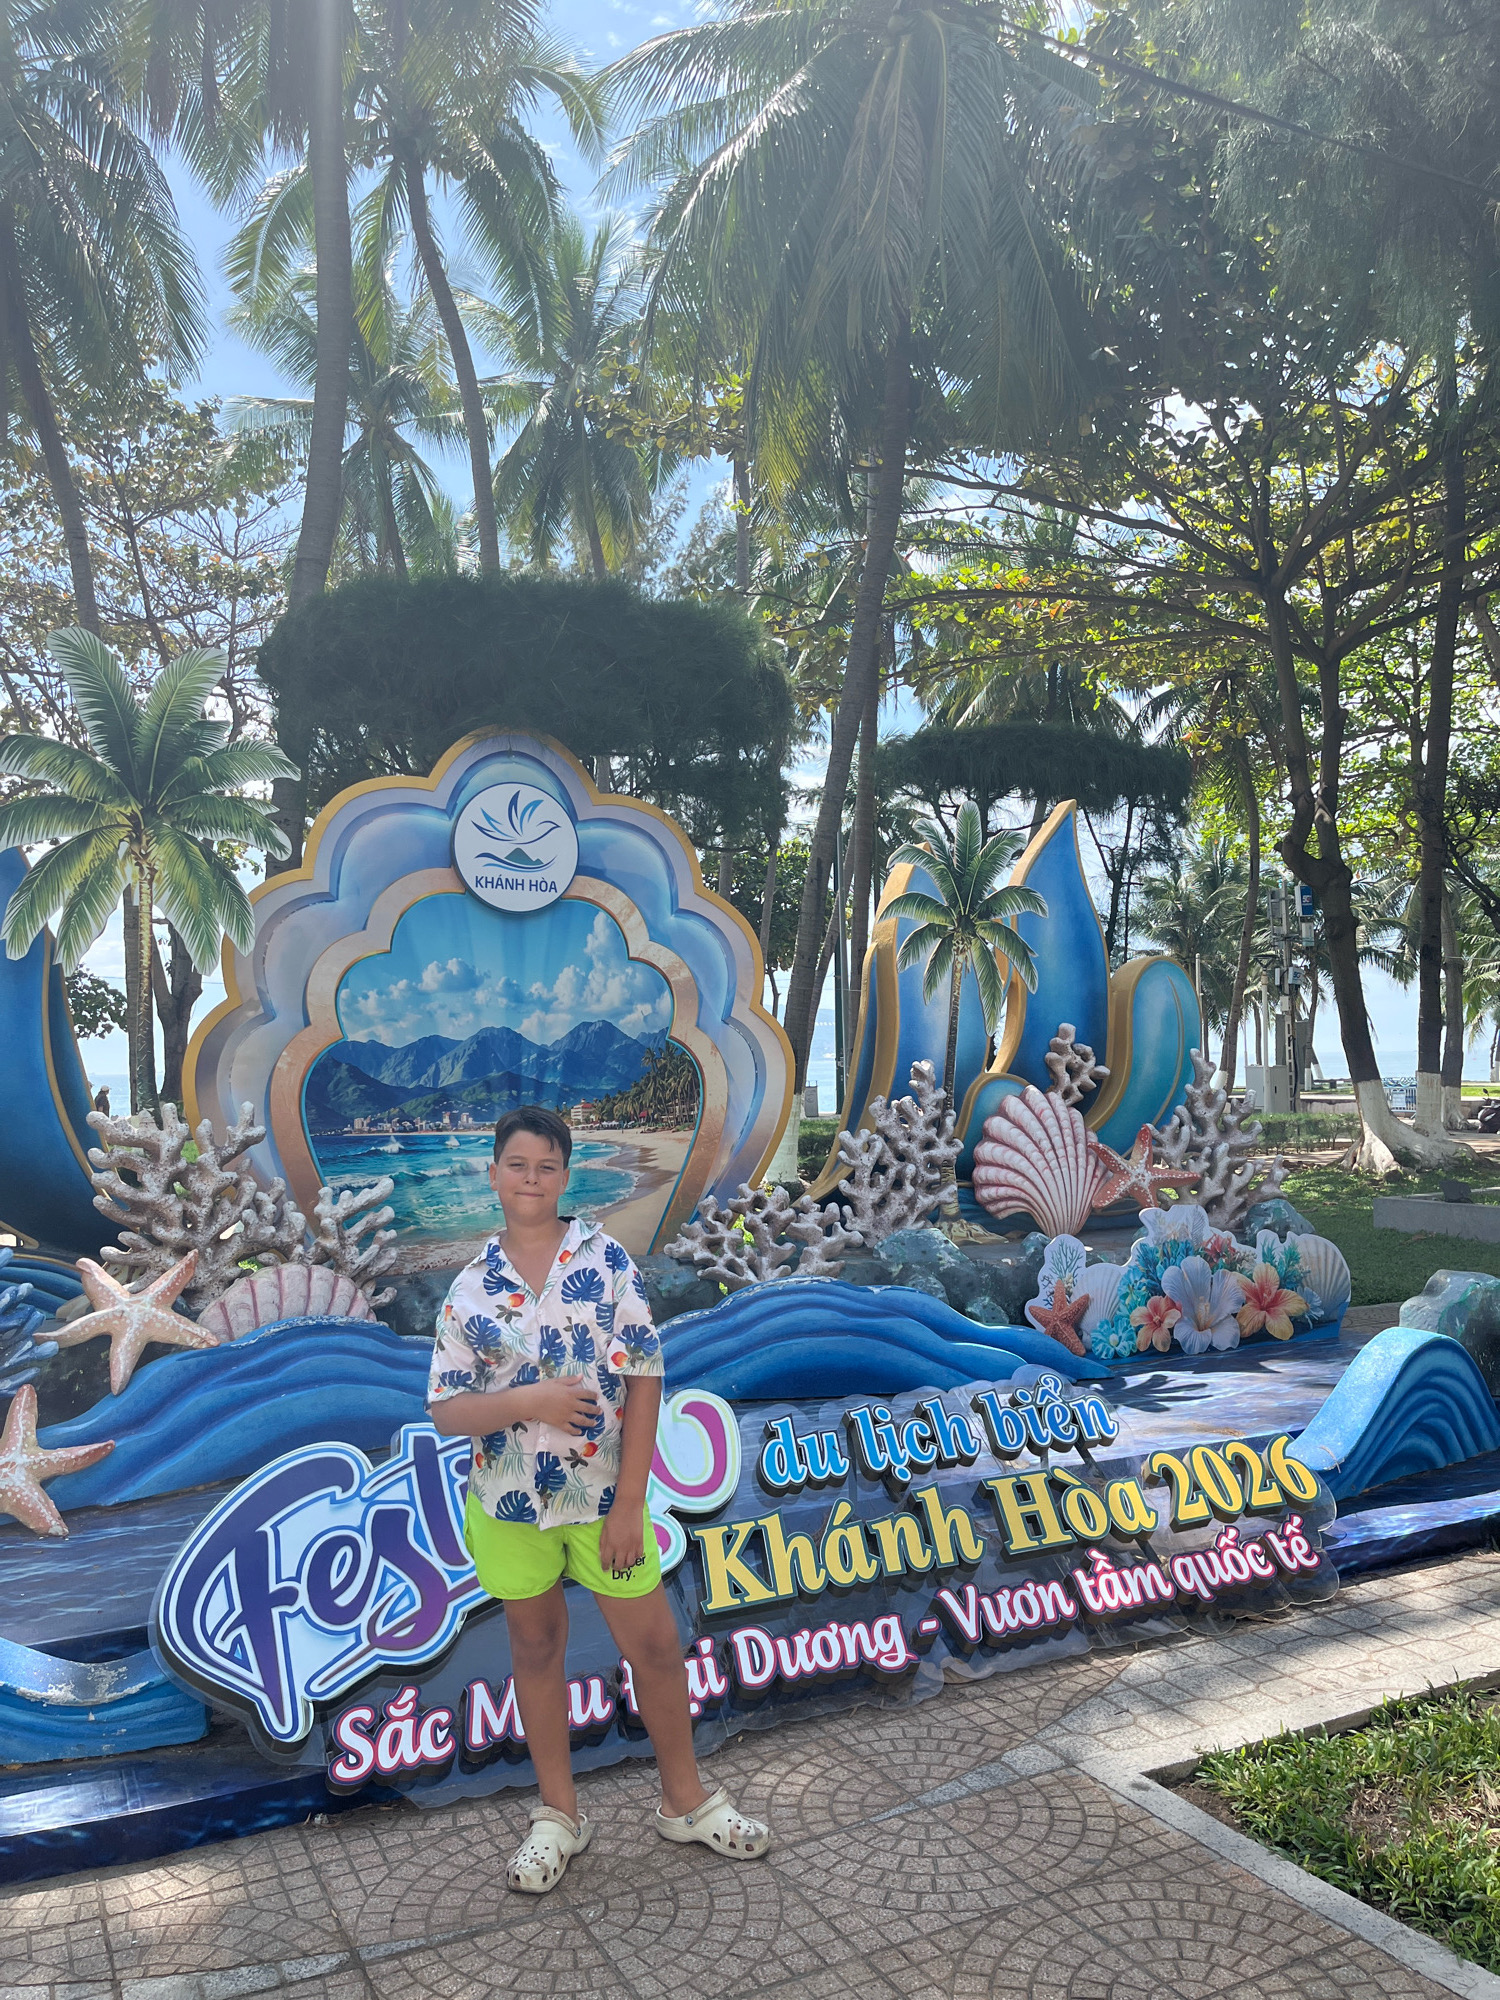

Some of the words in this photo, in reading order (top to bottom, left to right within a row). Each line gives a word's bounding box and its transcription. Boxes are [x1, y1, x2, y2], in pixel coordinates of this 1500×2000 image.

[475, 874, 525, 891] KHÁNH
[528, 877, 558, 893] HÒA
[761, 1416, 848, 1488] du
[850, 1396, 980, 1486] lịch
[979, 1372, 1120, 1453] biển
[163, 1390, 741, 1740] Fest
[690, 1480, 986, 1615] Khánh
[983, 1467, 1159, 1555] Hòa
[1152, 1433, 1322, 1531] 2026
[329, 1684, 456, 1788] Sắc
[464, 1672, 613, 1752] Mu
[732, 1612, 920, 1690] Dương
[920, 1615, 940, 1637] -
[936, 1577, 1078, 1644] Vươn
[1074, 1547, 1176, 1612] tầm
[1173, 1525, 1276, 1602] quốc
[1265, 1514, 1322, 1575] tế
